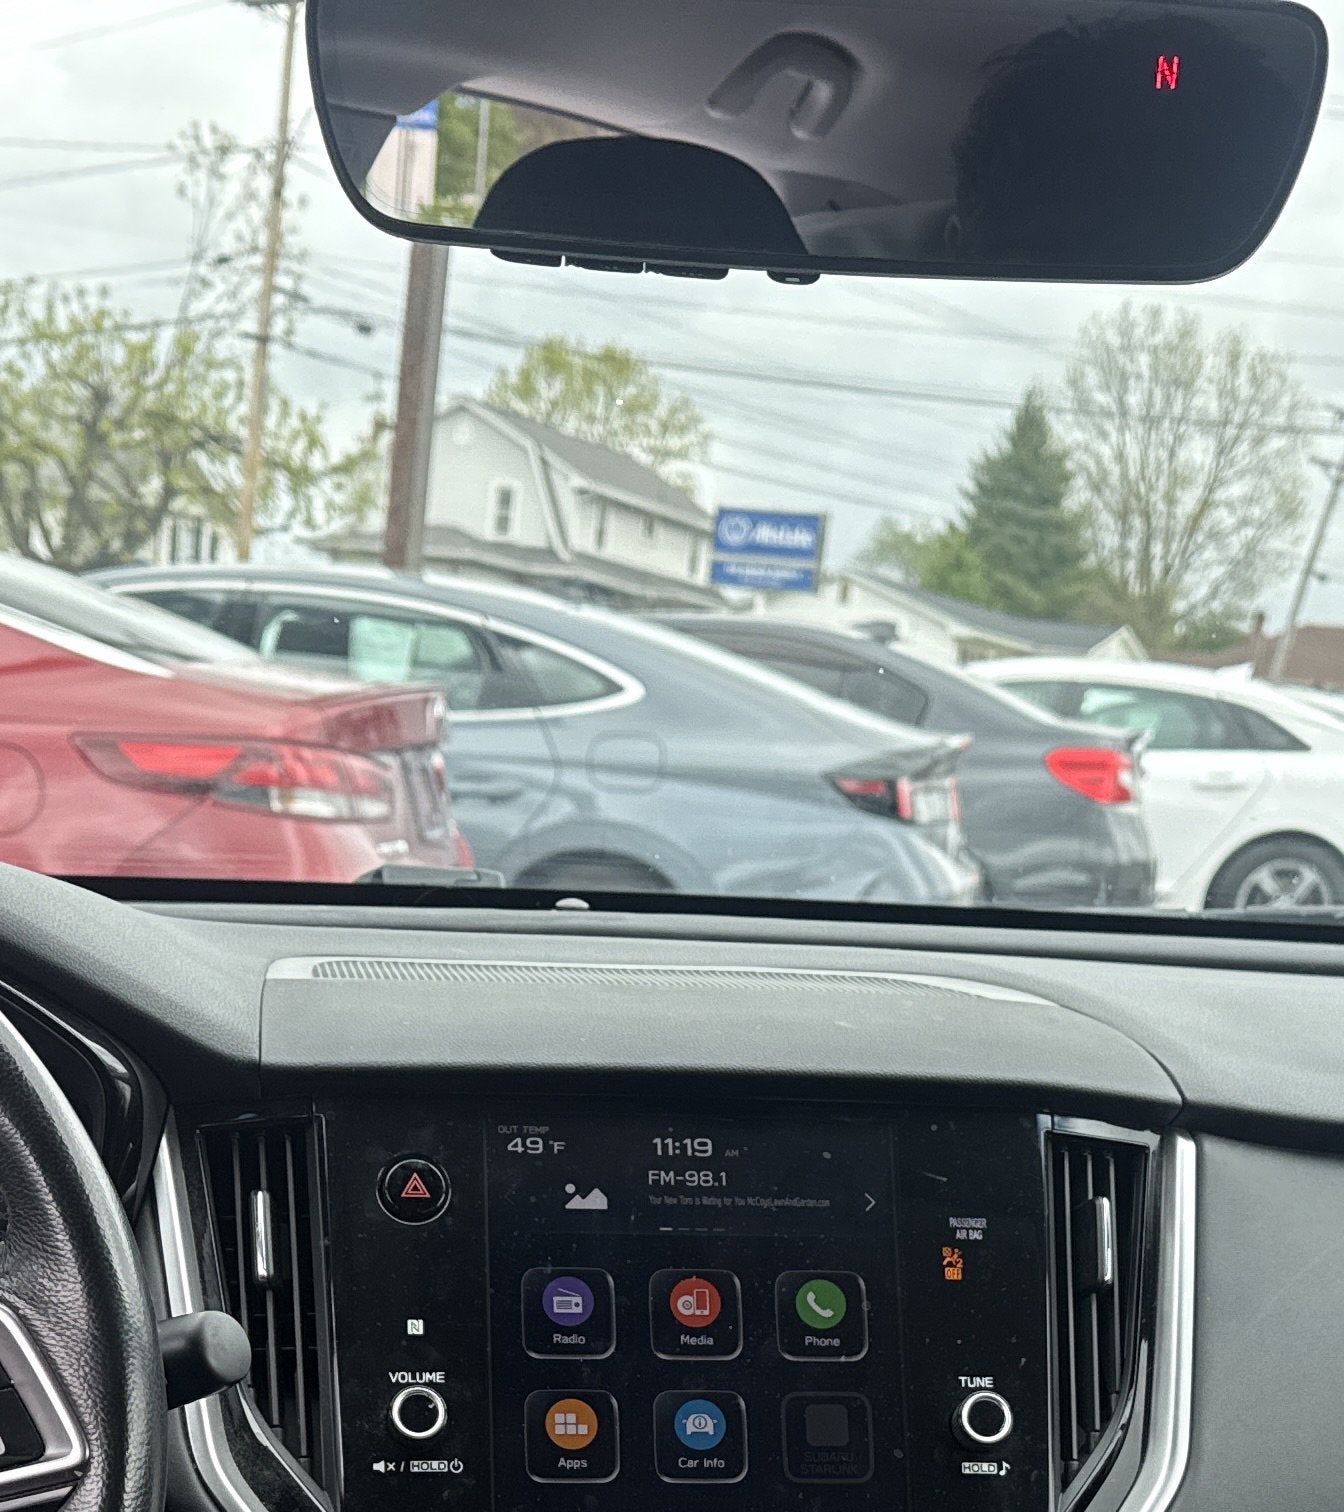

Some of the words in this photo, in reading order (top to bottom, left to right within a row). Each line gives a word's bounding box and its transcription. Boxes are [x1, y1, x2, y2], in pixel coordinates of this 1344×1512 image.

[1156, 55, 1179, 89] N
[522, 1125, 550, 1135] TEMP
[506, 1137, 544, 1154] 49
[652, 1137, 713, 1157] 11:19
[724, 1149, 739, 1158] AM
[648, 1170, 728, 1187] FM-98.1
[948, 1216, 987, 1229] PASSENGER
[955, 1229, 968, 1240] AIR
[968, 1229, 983, 1240] BAG
[945, 1268, 962, 1279] OFF
[553, 1334, 586, 1345] Radio
[680, 1334, 714, 1346] Media
[805, 1336, 841, 1348] Phone
[388, 1371, 446, 1383] VOLUME
[958, 1376, 994, 1388] TUNE
[410, 1460, 448, 1472] HOLD
[558, 1457, 588, 1470] Apps
[678, 1457, 700, 1469] Car
[703, 1457, 726, 1469] Info
[962, 1463, 997, 1474] HOLD
